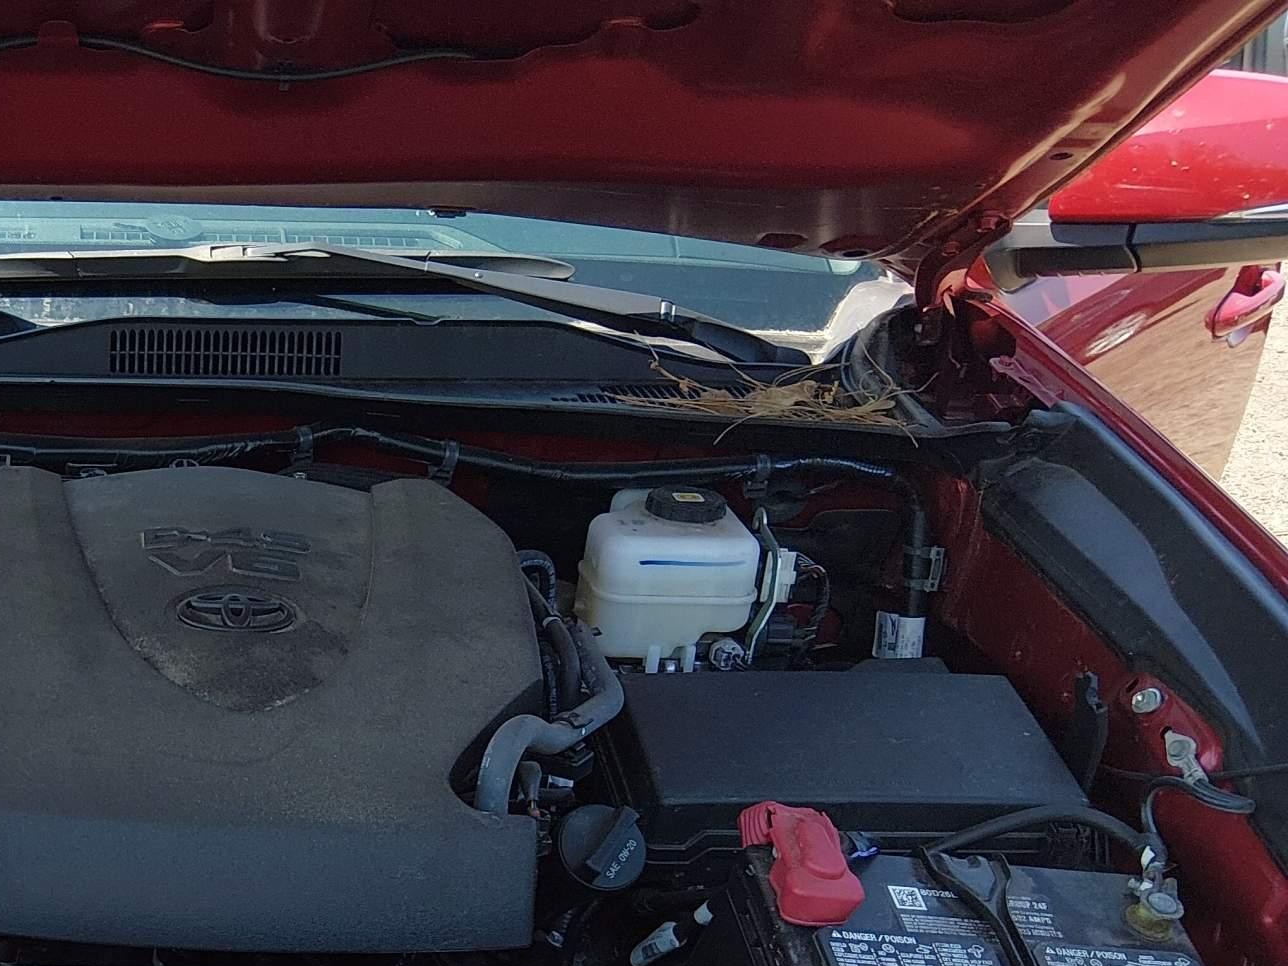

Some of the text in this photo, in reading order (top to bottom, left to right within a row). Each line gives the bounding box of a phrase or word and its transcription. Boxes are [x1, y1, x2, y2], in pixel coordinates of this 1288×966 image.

[146, 550, 302, 582] V6
[606, 839, 637, 879] SAE 0W-20
[842, 931, 877, 941] DANGER
[884, 935, 917, 944] POISON
[1055, 948, 1089, 957] DANGER
[1095, 951, 1127, 960] POISON
